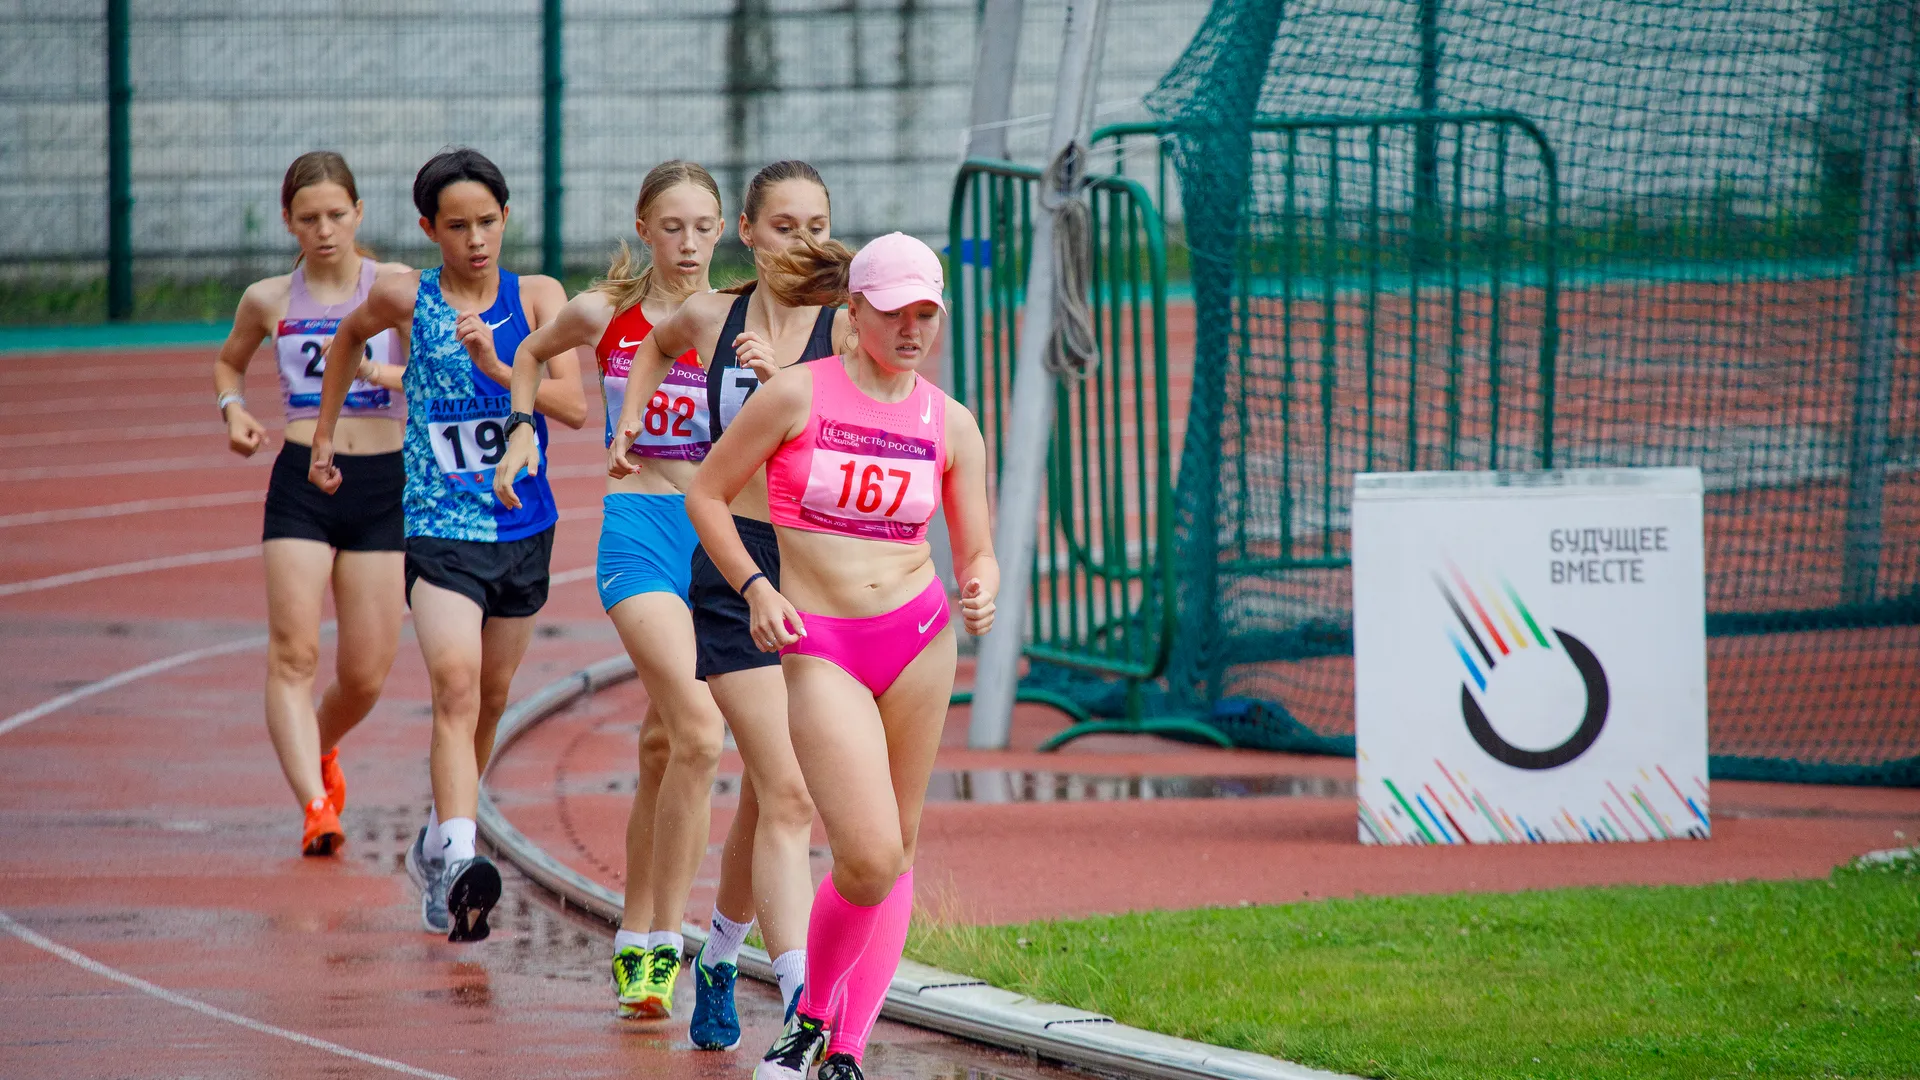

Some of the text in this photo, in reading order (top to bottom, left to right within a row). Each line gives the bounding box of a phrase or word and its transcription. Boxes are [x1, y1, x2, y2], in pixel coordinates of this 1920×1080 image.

[677, 370, 707, 382] РОСС
[430, 398, 479, 413] ANTA
[645, 390, 695, 436] 82
[823, 427, 927, 455] ПЕРВЕНСТВО РОССИИ
[837, 460, 911, 517] 167
[1550, 526, 1668, 555] БУДУЩЕЕ
[1551, 558, 1644, 583] ВМЕСТЕ
